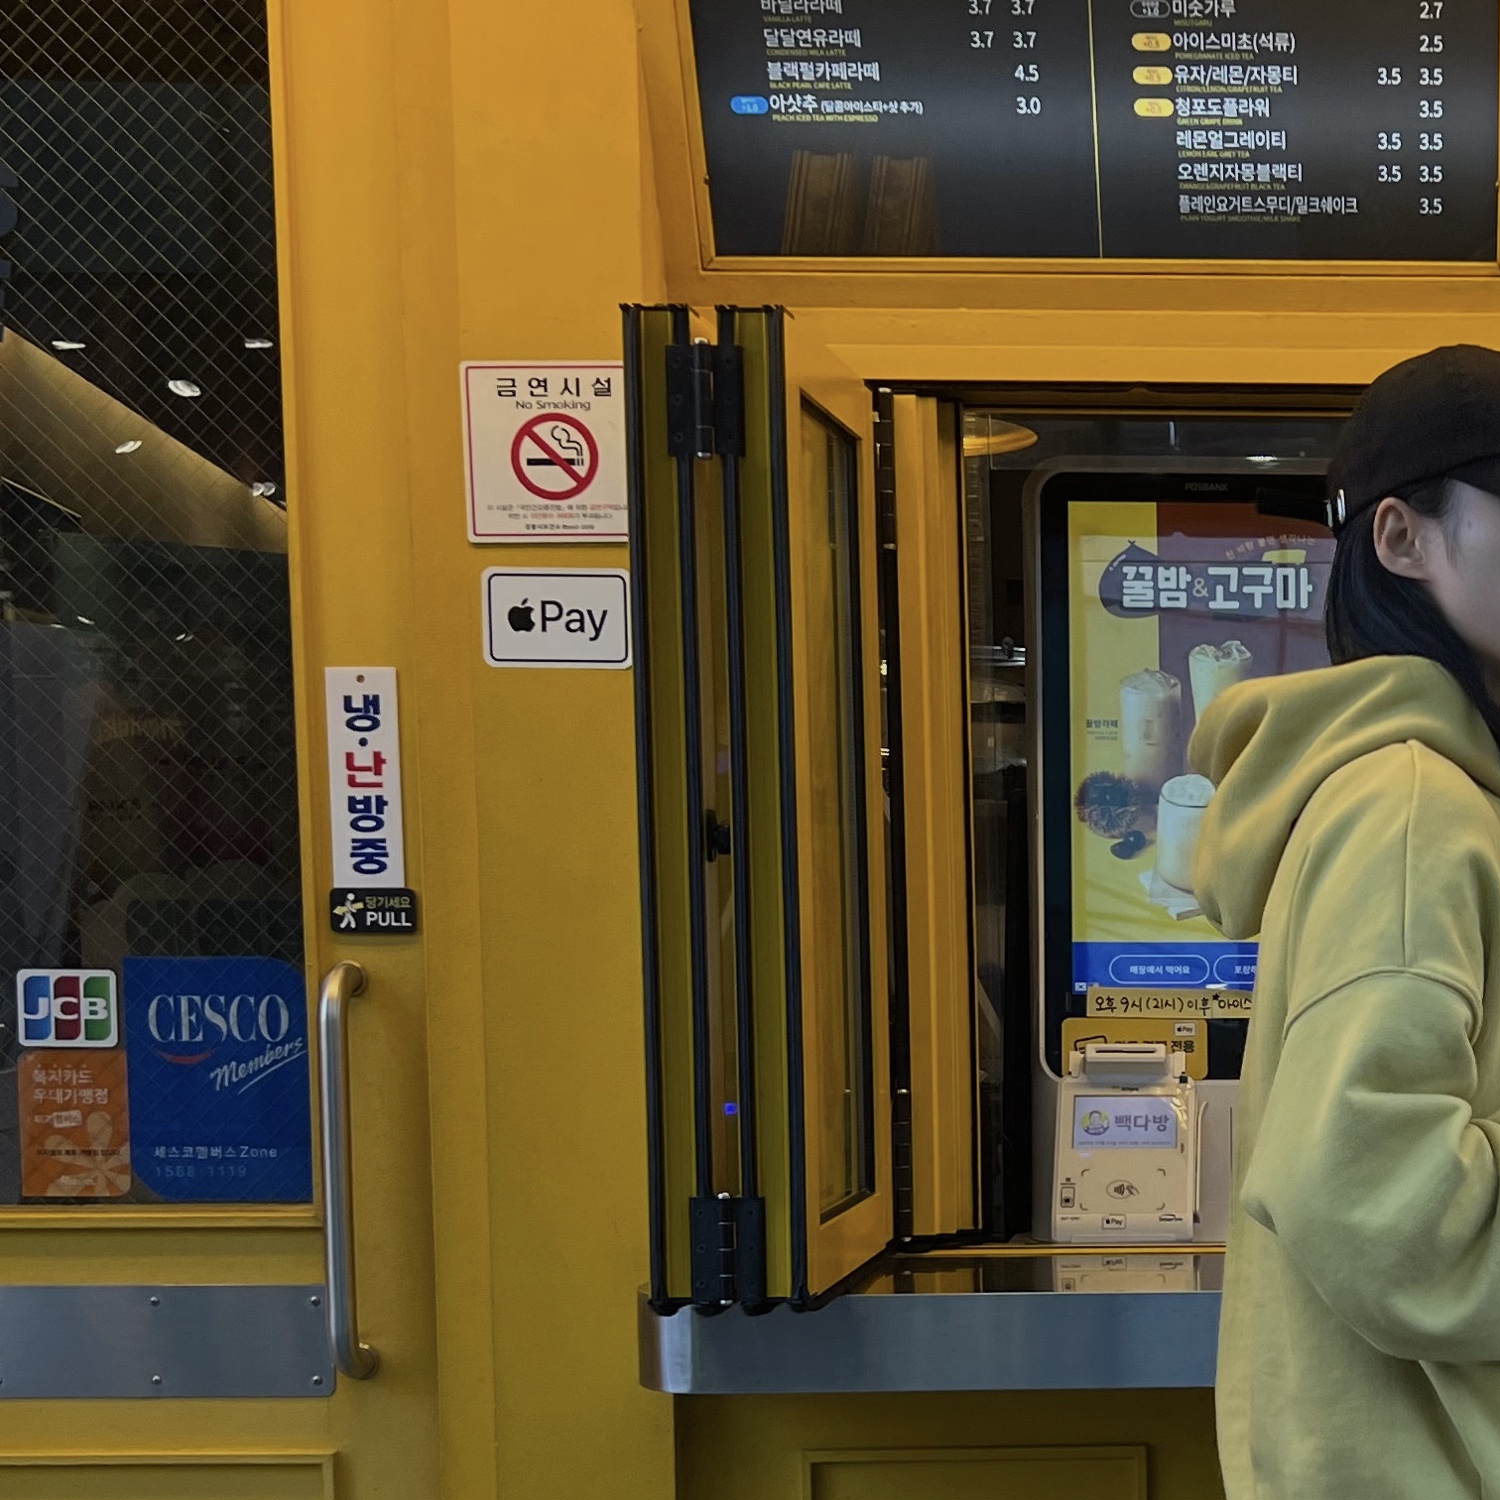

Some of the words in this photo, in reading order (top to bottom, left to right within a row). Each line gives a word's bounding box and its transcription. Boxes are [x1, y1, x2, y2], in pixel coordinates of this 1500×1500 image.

[969, 0, 992, 15] 3.7
[1011, 0, 1035, 15] 3.7
[1172, 0, 1237, 17] 미숫가루
[1419, 1, 1443, 19] 2.7
[763, 28, 862, 48] 달달연유라떼
[970, 31, 994, 48] 3.7
[1013, 31, 1037, 48] 3.7
[1173, 32, 1296, 54] 아이스미초(석류)
[1419, 34, 1443, 52] 2.5
[767, 61, 881, 82] 블랙펄카페라떼
[1014, 64, 1039, 82] 4.5
[1174, 65, 1298, 86] 유자/레몬/자몽티
[1377, 67, 1402, 85] 3.5
[1419, 68, 1443, 86] 3.5
[769, 93, 818, 114] 아샷추
[1016, 97, 1041, 115] 3.0
[1419, 100, 1443, 118] 3.5
[1176, 130, 1287, 150] 레몬얼그레이티
[1378, 133, 1402, 150] 3.5
[1419, 133, 1443, 150] 3.5
[1178, 163, 1302, 183] 오렌지자몽블랙티
[1378, 165, 1402, 182] 3.5
[1419, 166, 1443, 183] 3.5
[1419, 198, 1443, 215] 3.5
[516, 400, 533, 410] No
[536, 400, 591, 411] Smoking
[541, 600, 608, 642] Pay
[365, 896, 411, 909] 당기세요
[366, 911, 412, 927] PULL
[23, 997, 109, 1020] JCB
[1095, 996, 1117, 1013] 오후
[148, 994, 290, 1042] CESCO
[210, 1036, 303, 1091] Members
[1114, 1114, 1170, 1132] 빽다방
[155, 1165, 195, 1178] 1588
[208, 1165, 248, 1178] 1119
